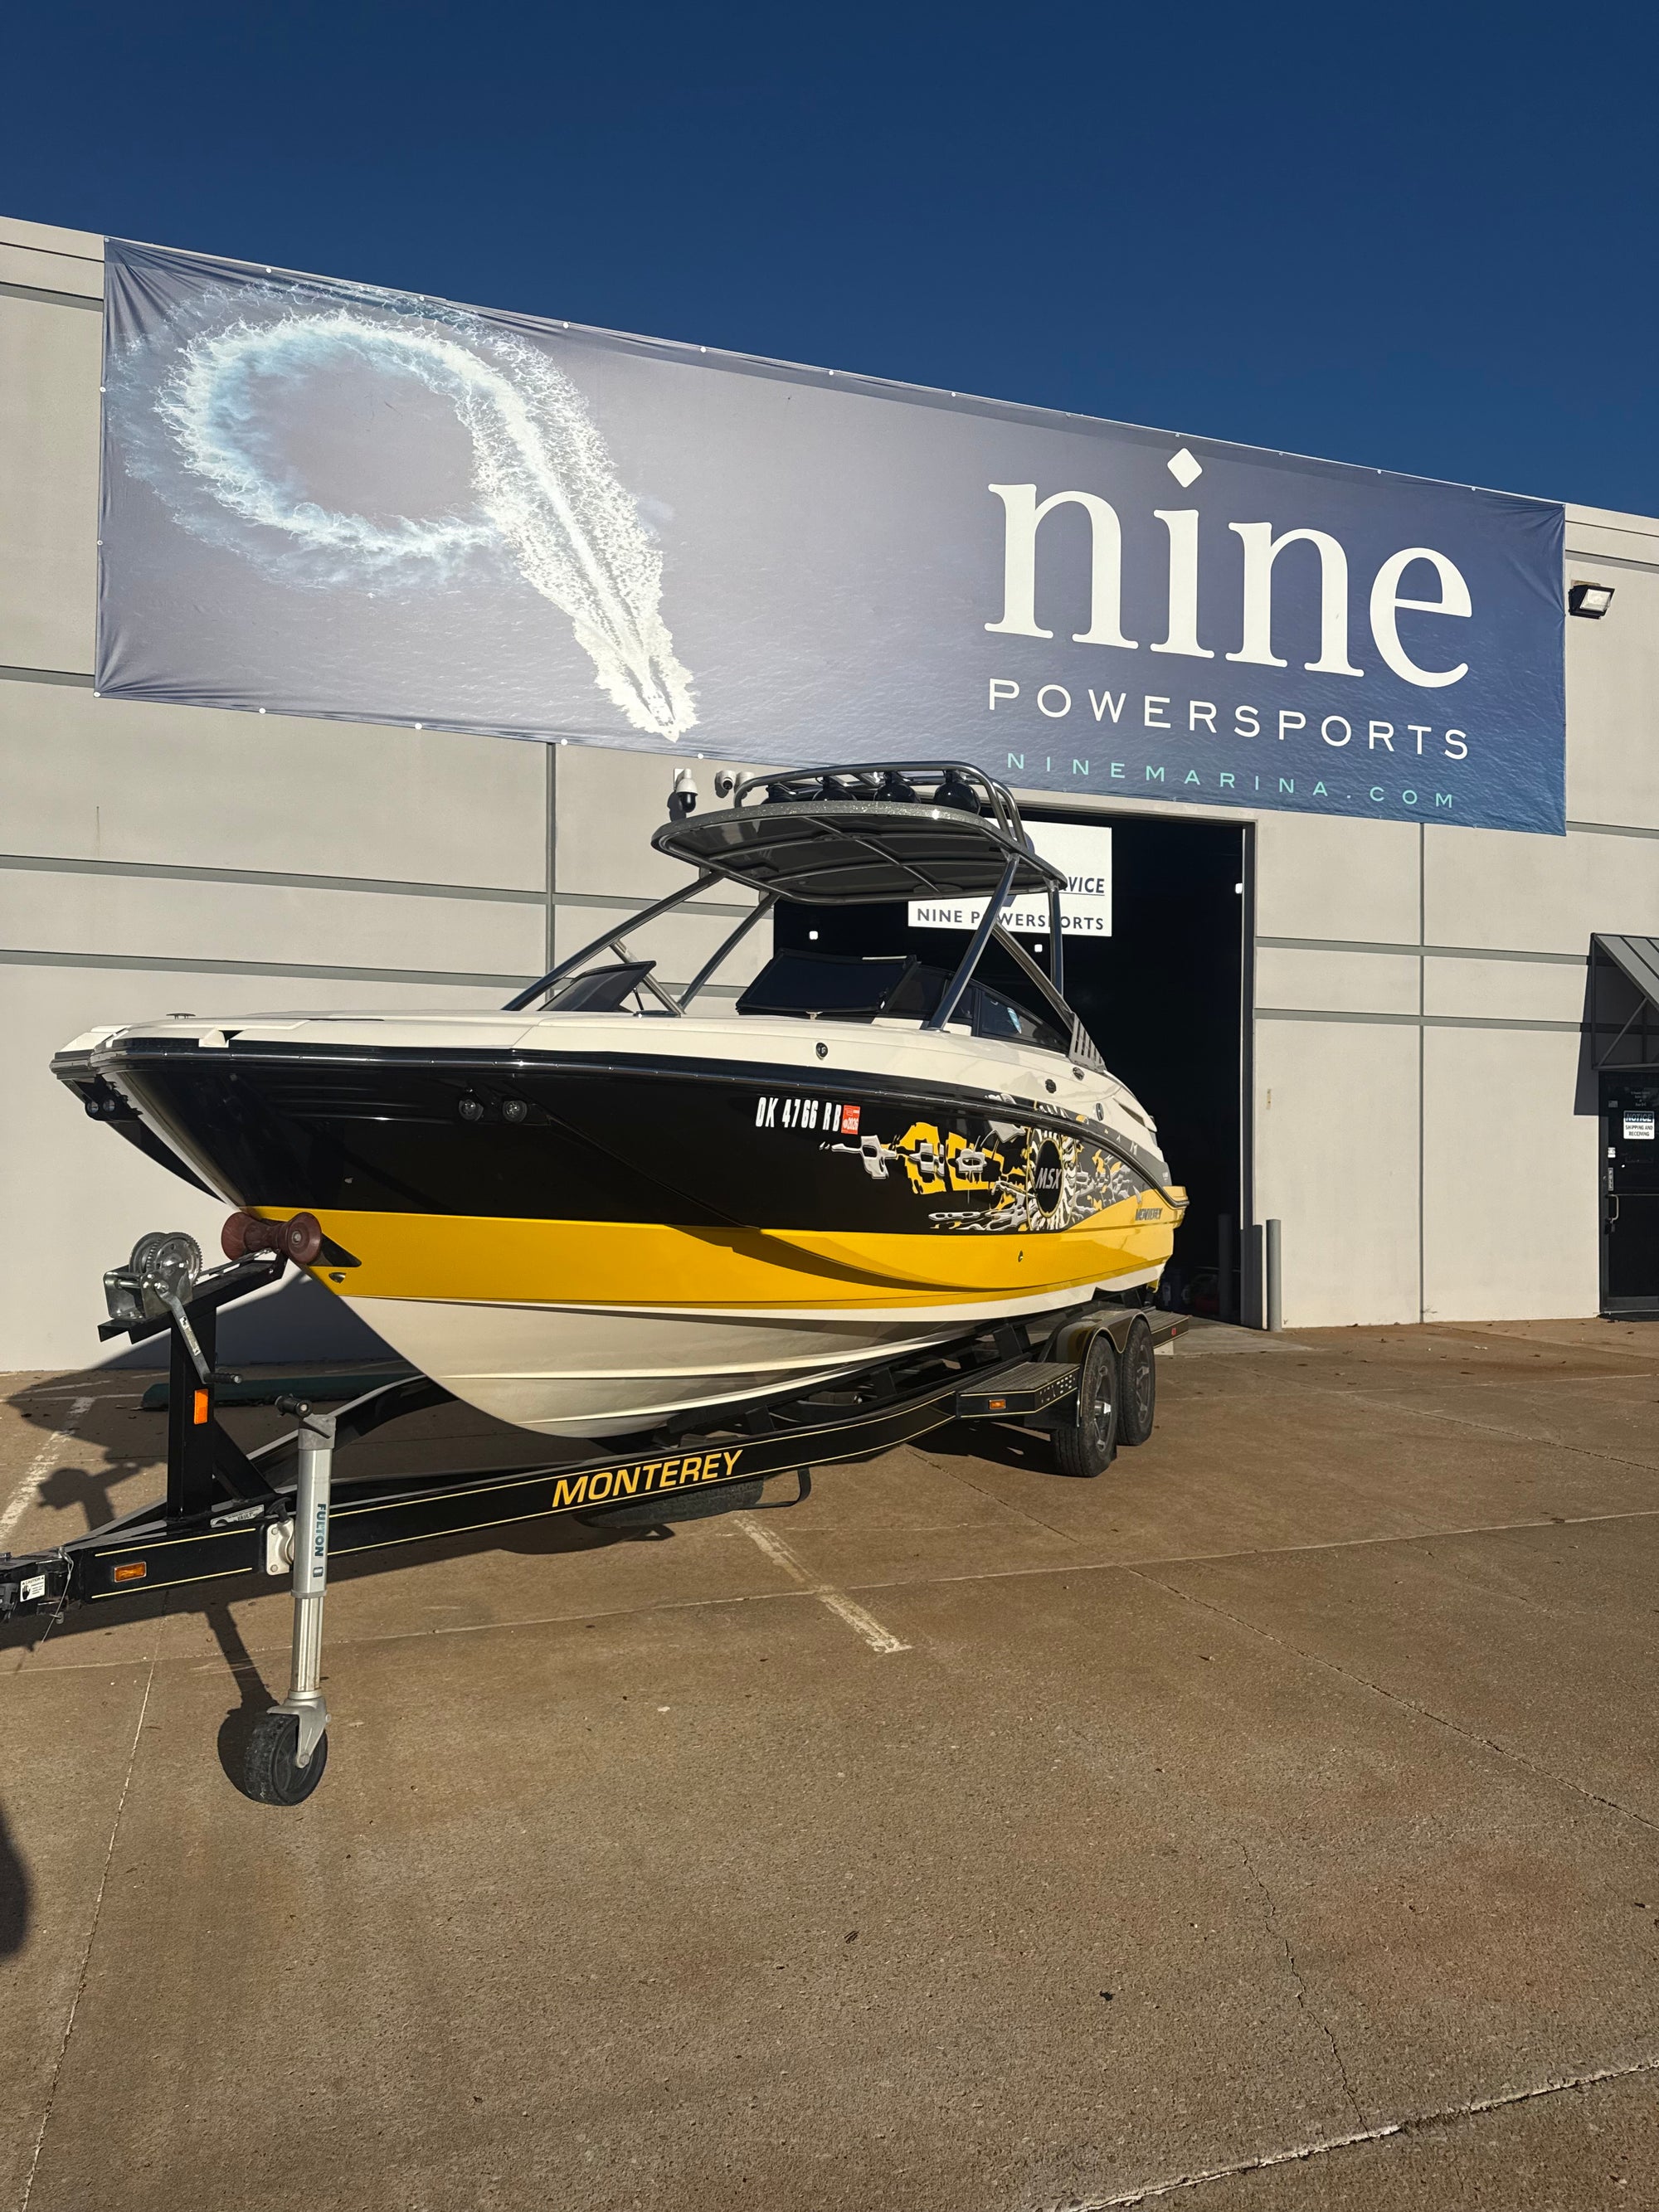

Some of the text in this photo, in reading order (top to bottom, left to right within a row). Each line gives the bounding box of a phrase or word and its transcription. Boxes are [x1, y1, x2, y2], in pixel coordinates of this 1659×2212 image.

[985, 448, 1472, 688] nine
[988, 678, 1468, 760] POWERSPORTS
[1006, 752, 1453, 809] NINEMARINA.COM
[1063, 876, 1105, 893] VICE
[917, 908, 1104, 931] NINE PWERSORTS
[756, 1096, 779, 1128] OK
[781, 1098, 819, 1129] 4766
[1626, 1113, 1652, 1122] NOTICE
[1035, 1167, 1063, 1189] MSX
[552, 1449, 743, 1508] MONTEREY
[237, 1512, 253, 1521] VAULT
[314, 1503, 327, 1557] FULTON
